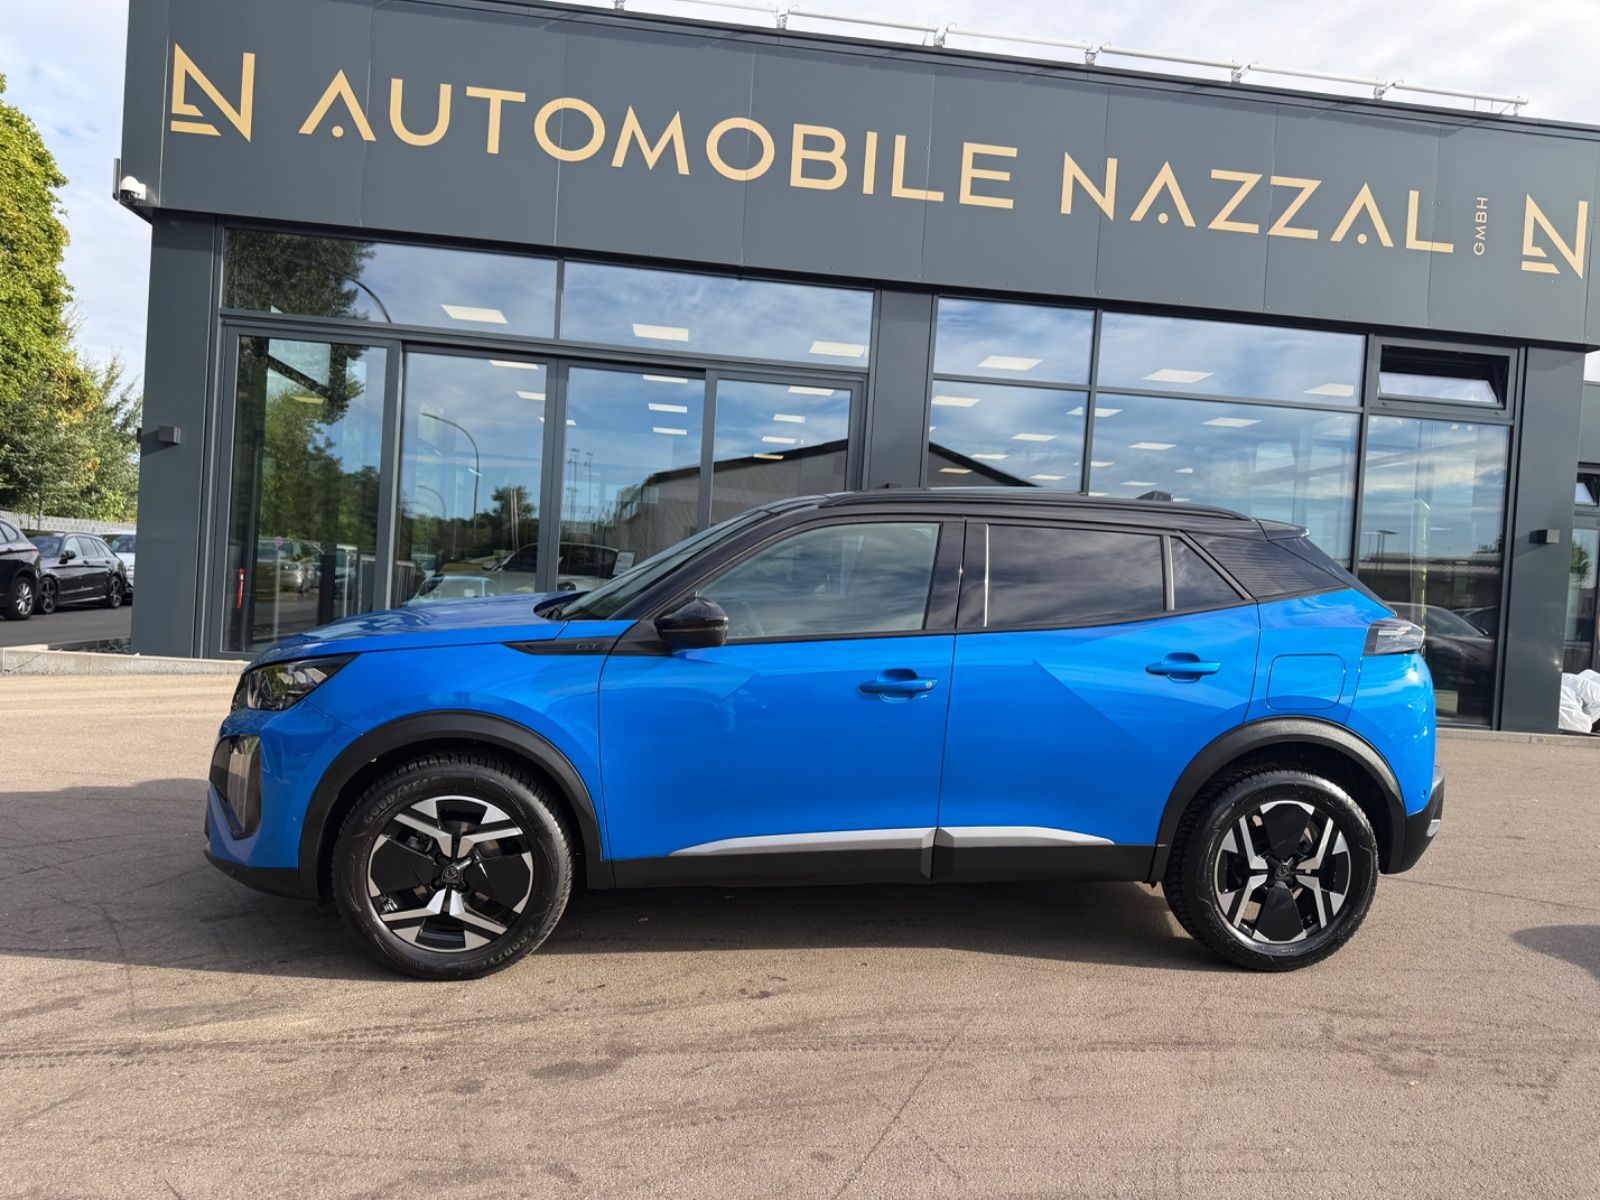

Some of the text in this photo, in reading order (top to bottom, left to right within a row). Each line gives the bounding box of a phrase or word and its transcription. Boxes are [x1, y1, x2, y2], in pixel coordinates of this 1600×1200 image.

[299, 69, 1454, 255] AUTOMOBILE NAZZAL
[1473, 196, 1489, 256] GMBH
